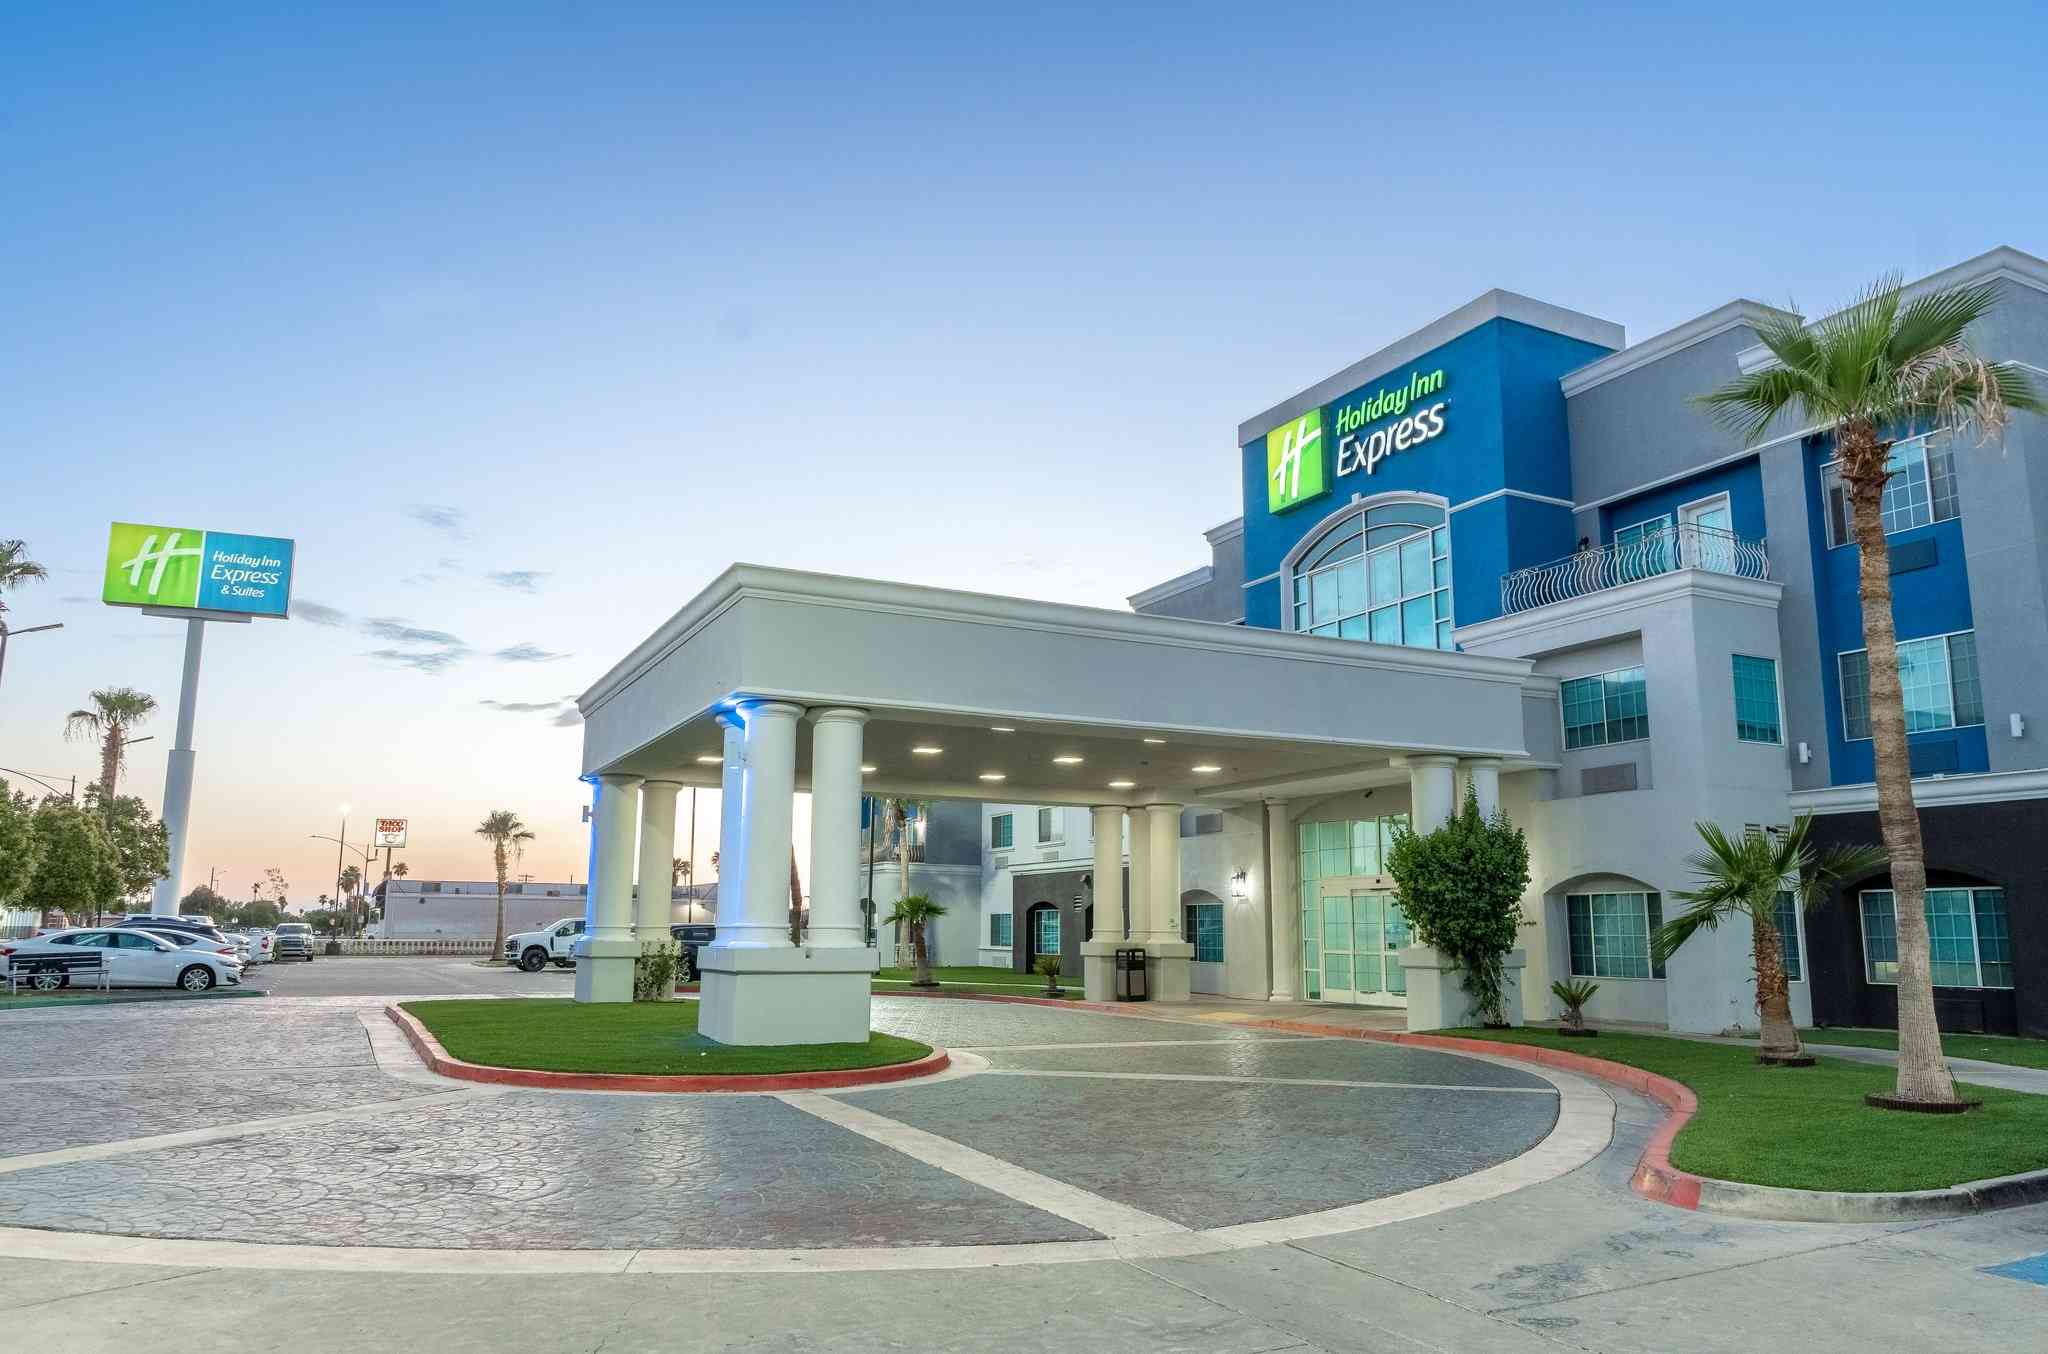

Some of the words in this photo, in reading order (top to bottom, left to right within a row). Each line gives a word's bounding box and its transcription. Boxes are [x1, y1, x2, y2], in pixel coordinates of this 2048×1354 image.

[1336, 386, 1409, 435] Holiday
[1411, 369, 1443, 400] Inn
[1337, 403, 1445, 477] Express
[213, 550, 260, 568] Holiday
[261, 555, 281, 567] Inn
[211, 564, 279, 585] Express
[221, 584, 229, 595] &
[231, 586, 265, 598] Suites
